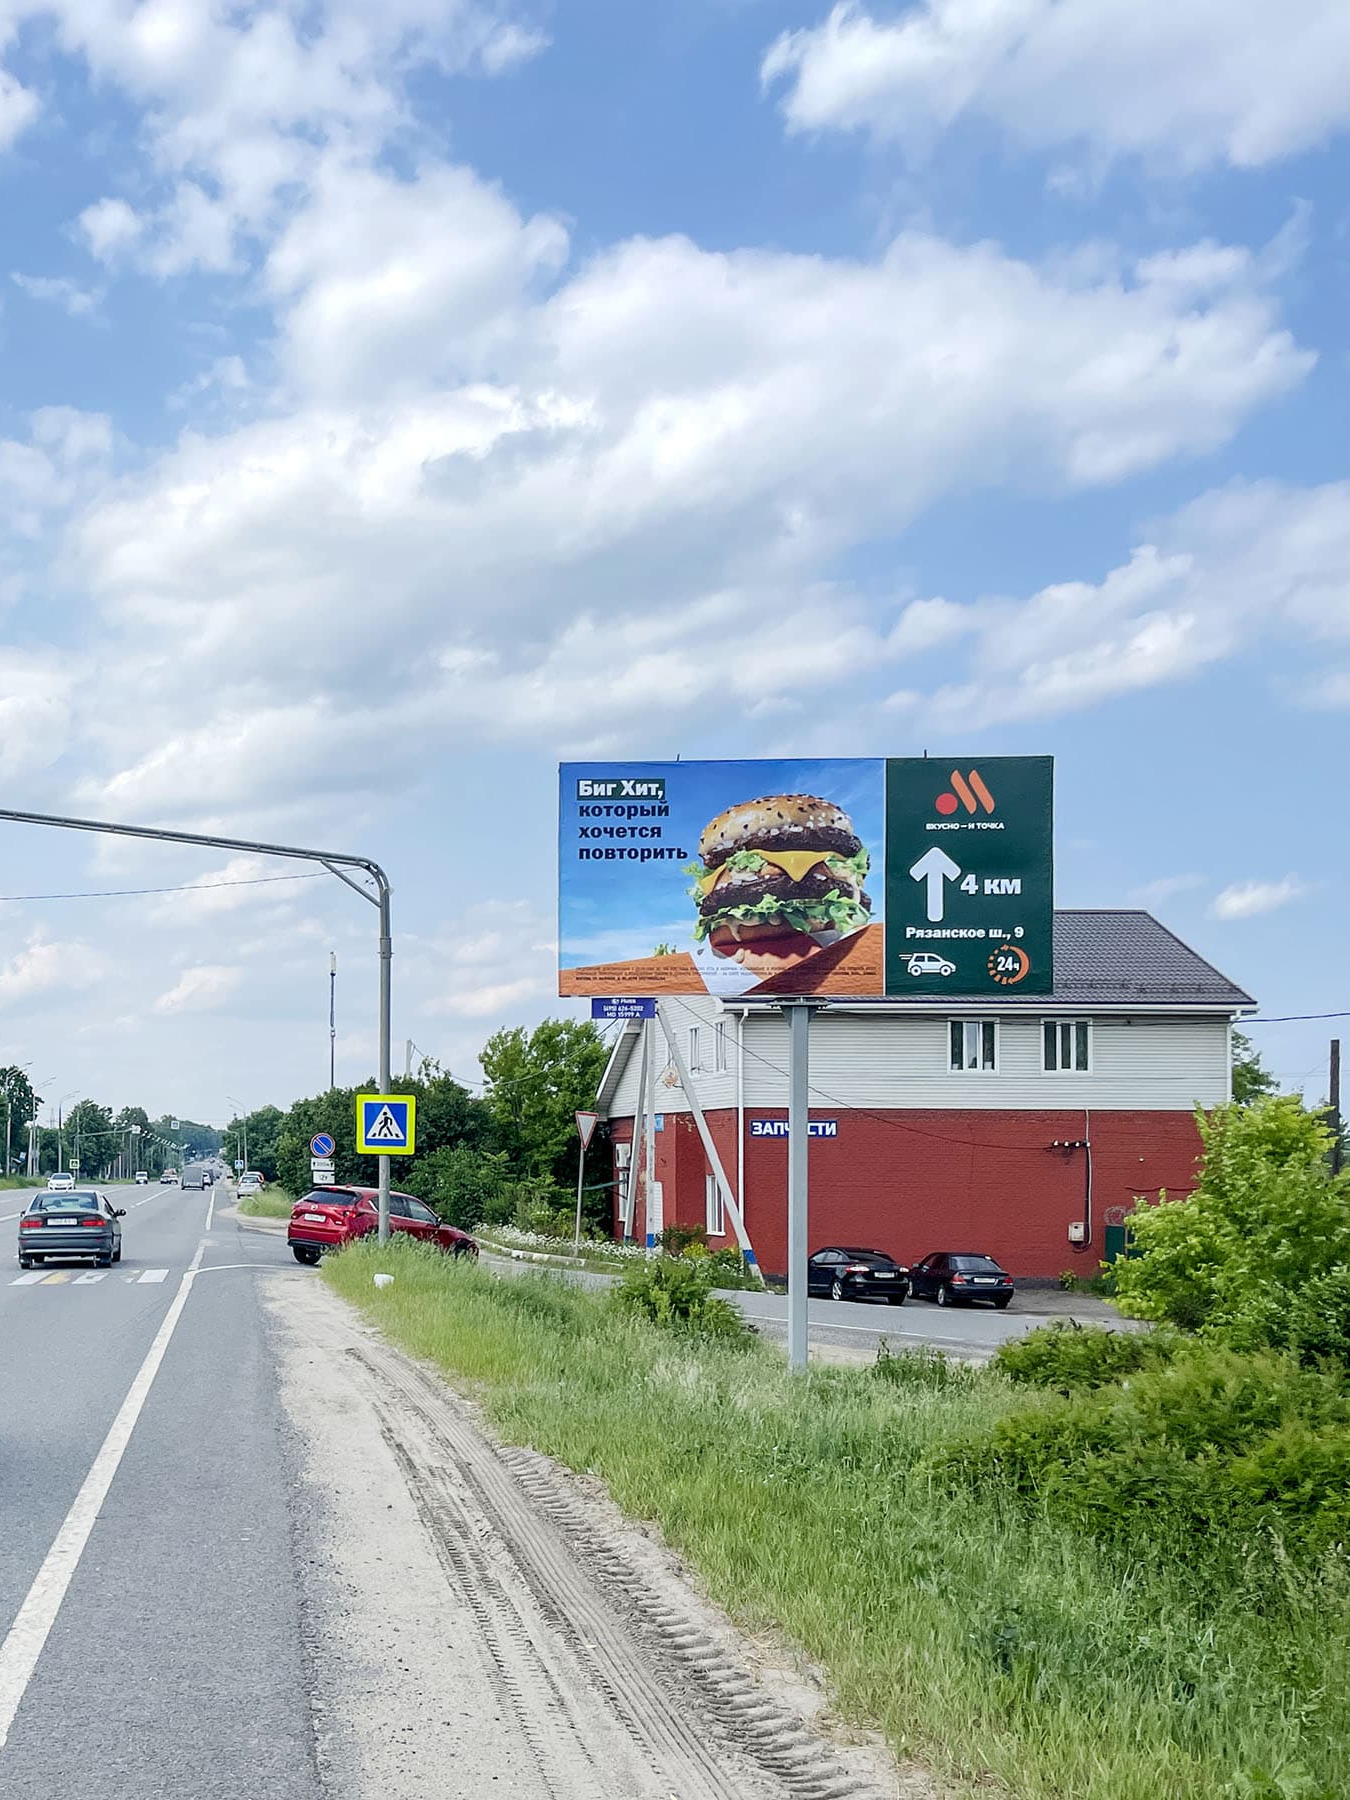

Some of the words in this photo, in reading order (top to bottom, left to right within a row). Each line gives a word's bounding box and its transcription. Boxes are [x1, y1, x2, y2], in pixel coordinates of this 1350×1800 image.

[578, 780, 617, 796] Биг
[620, 780, 664, 799] Хит,
[579, 800, 669, 820] который
[578, 826, 662, 838] хочется
[925, 822, 960, 831] ВКУСНО
[976, 822, 1005, 830] ТОЧКА
[578, 848, 688, 863] повторить
[960, 874, 979, 894] 4
[983, 878, 1022, 895] км
[905, 926, 986, 939] Рязанское
[988, 928, 1012, 940] ш.,
[1014, 926, 1025, 938] 9
[997, 956, 1020, 971] 24ч
[752, 1122, 837, 1136] ЗАПСТИ
